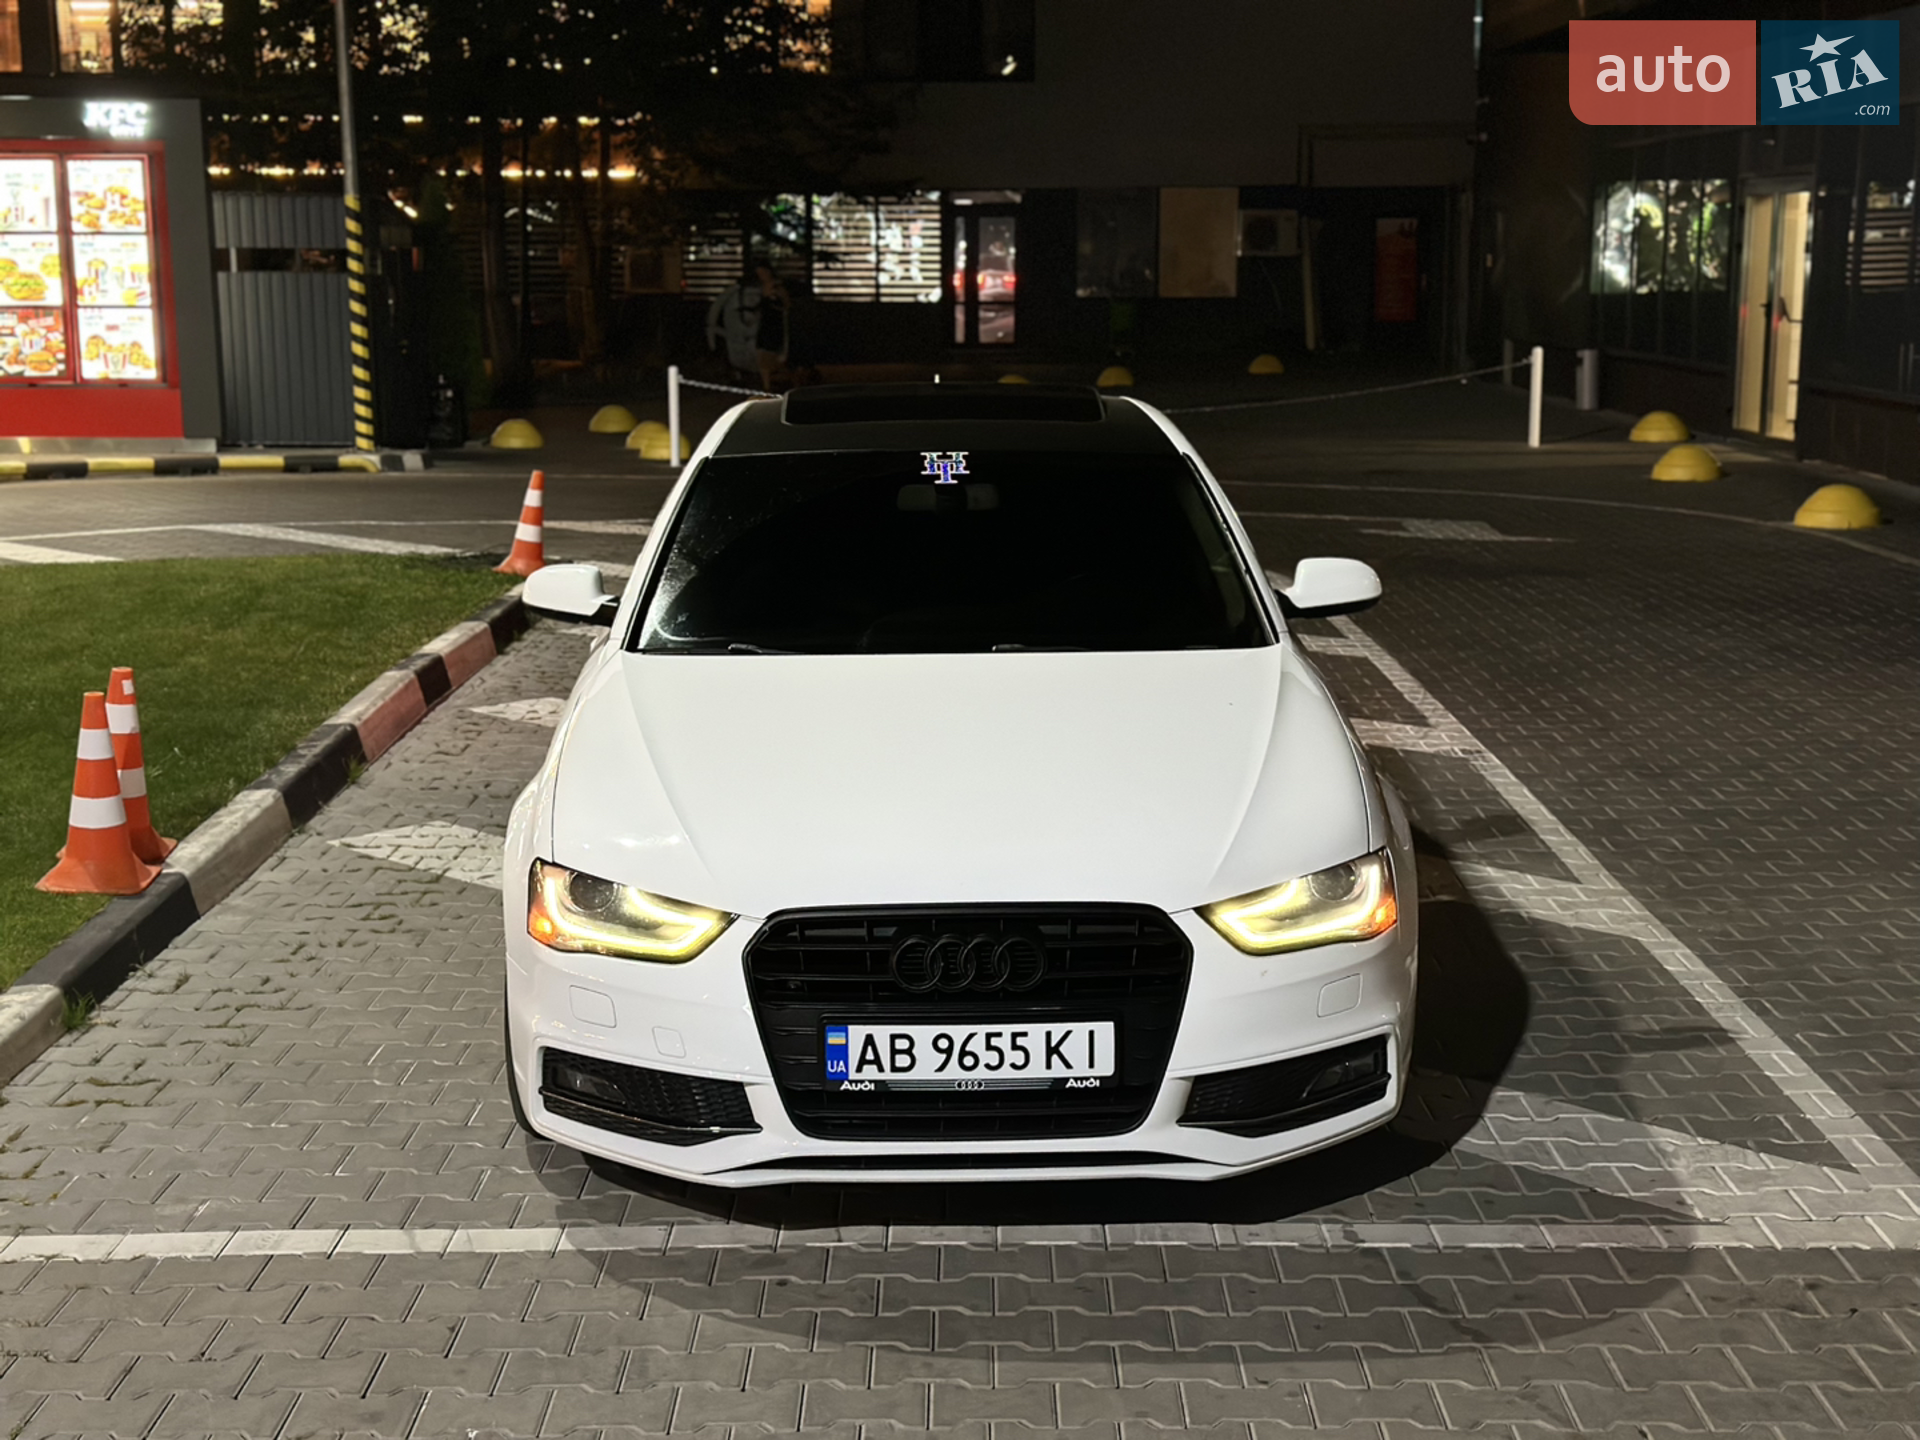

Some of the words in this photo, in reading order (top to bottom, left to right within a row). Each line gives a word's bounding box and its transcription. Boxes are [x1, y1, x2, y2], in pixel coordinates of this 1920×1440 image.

[82, 101, 149, 128] KFC
[854, 1033, 917, 1073] AB
[931, 1031, 1031, 1072] 9655
[1044, 1029, 1095, 1070] KI
[827, 1060, 847, 1073] UA
[839, 1080, 875, 1091] Audi
[1065, 1078, 1101, 1089] Audi
